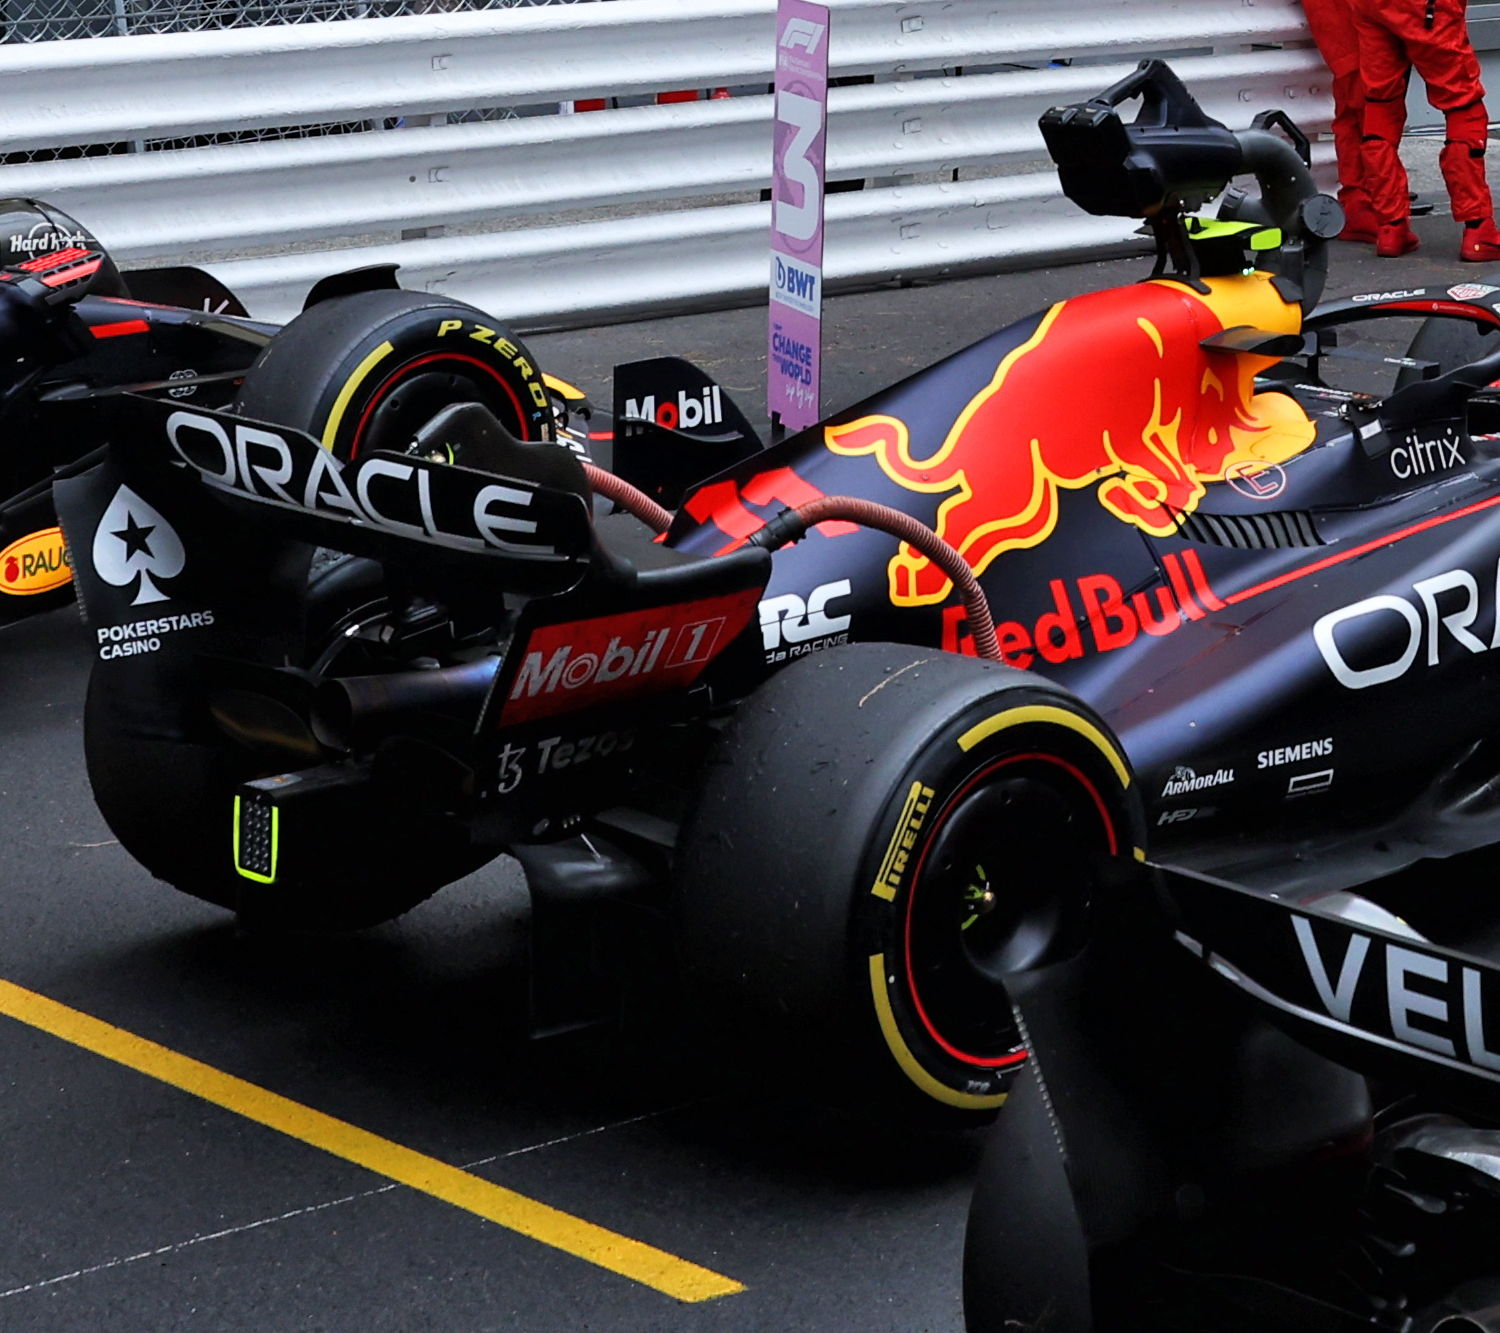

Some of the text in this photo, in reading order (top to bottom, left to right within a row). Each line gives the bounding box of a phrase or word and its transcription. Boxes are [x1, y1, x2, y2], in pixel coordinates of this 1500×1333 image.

[776, 89, 823, 241] 3
[9, 232, 49, 253] Hard
[787, 266, 816, 302] BWT
[1352, 286, 1427, 303] ORACLE
[438, 319, 549, 409] P ZERO
[773, 333, 812, 367] CHANGE
[780, 358, 812, 386] WORLD
[623, 385, 723, 439] Mobil
[165, 409, 541, 556] ORACLE
[758, 579, 852, 651] RC
[1095, 549, 1228, 654] Bull
[97, 610, 215, 644] POKERSTARS
[789, 632, 850, 658] RACING
[100, 636, 161, 661] CASINO
[510, 627, 671, 701] Mobil
[537, 728, 637, 774] Tezos
[1257, 737, 1333, 769] SIEMENS
[871, 780, 936, 902] PIRELLI
